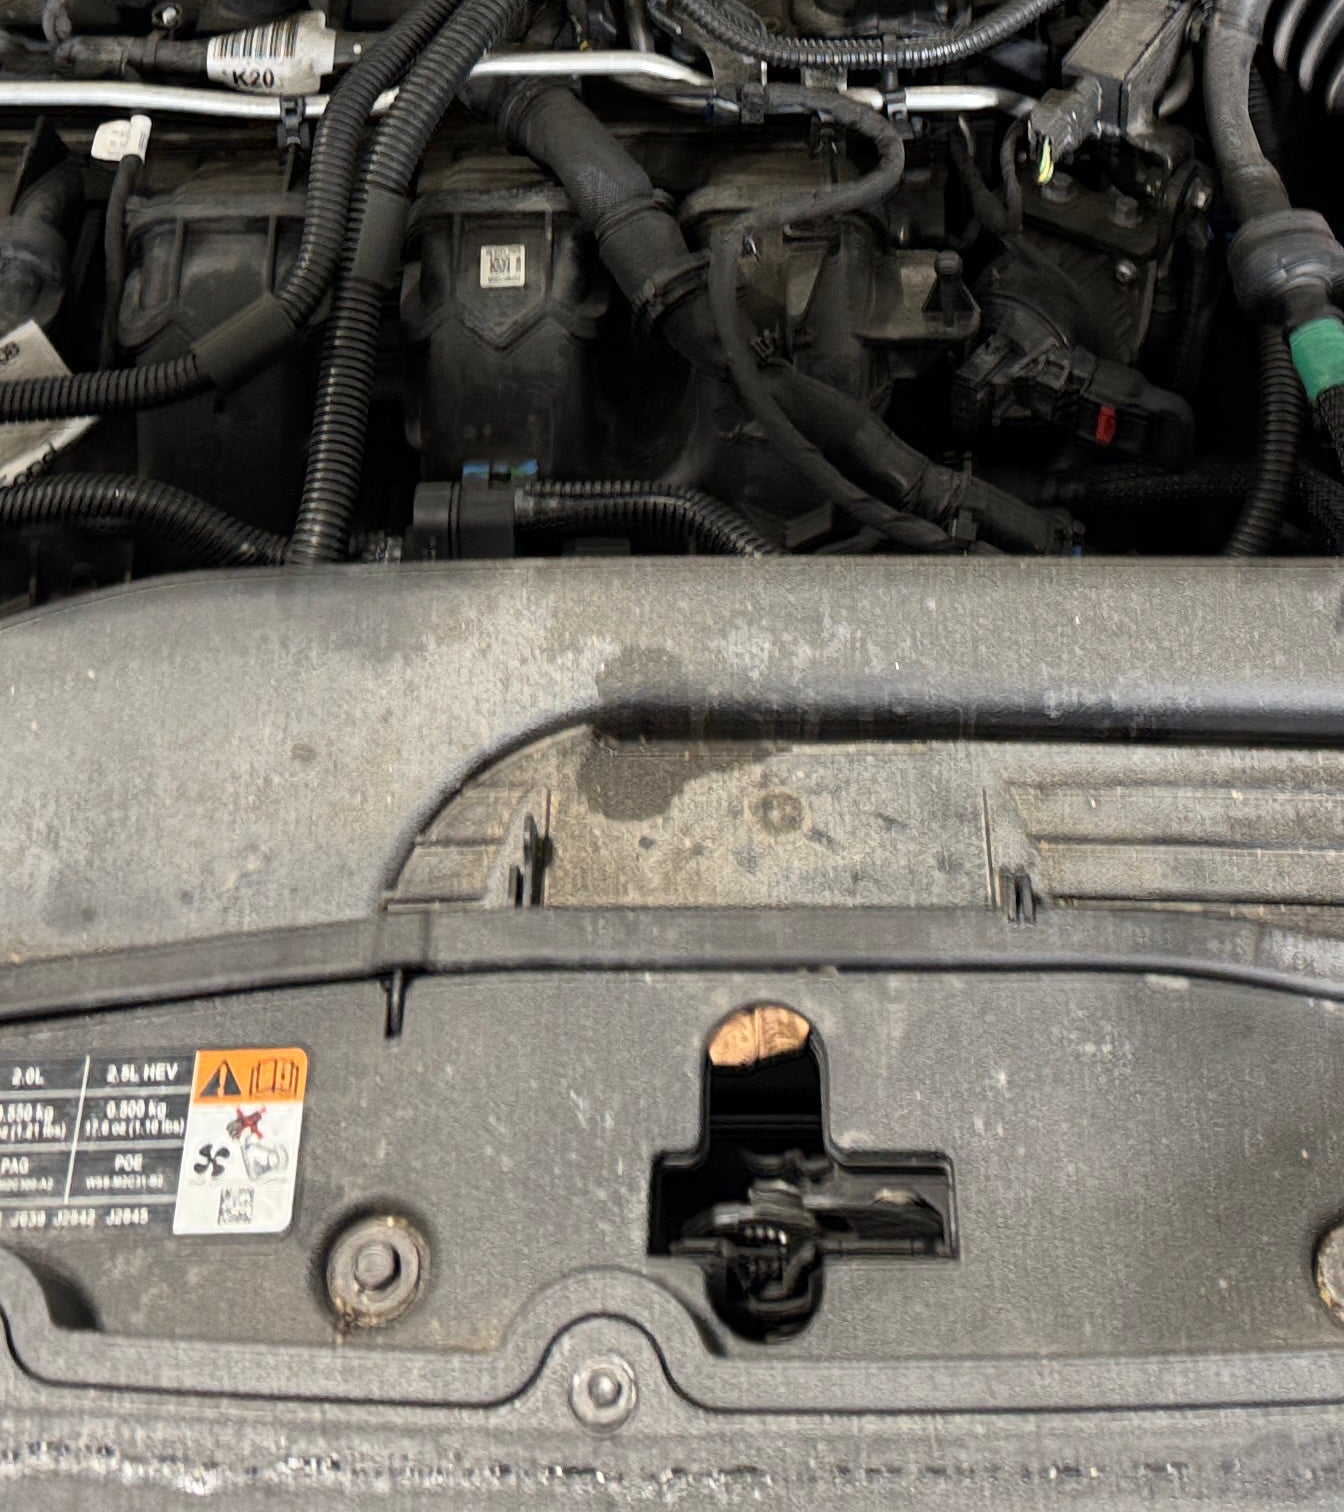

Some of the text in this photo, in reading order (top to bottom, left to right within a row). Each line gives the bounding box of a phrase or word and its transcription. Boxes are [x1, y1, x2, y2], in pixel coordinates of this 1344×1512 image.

[231, 68, 275, 89] K20
[12, 1065, 45, 1086] 2.0L
[143, 1062, 179, 1082] HEV
